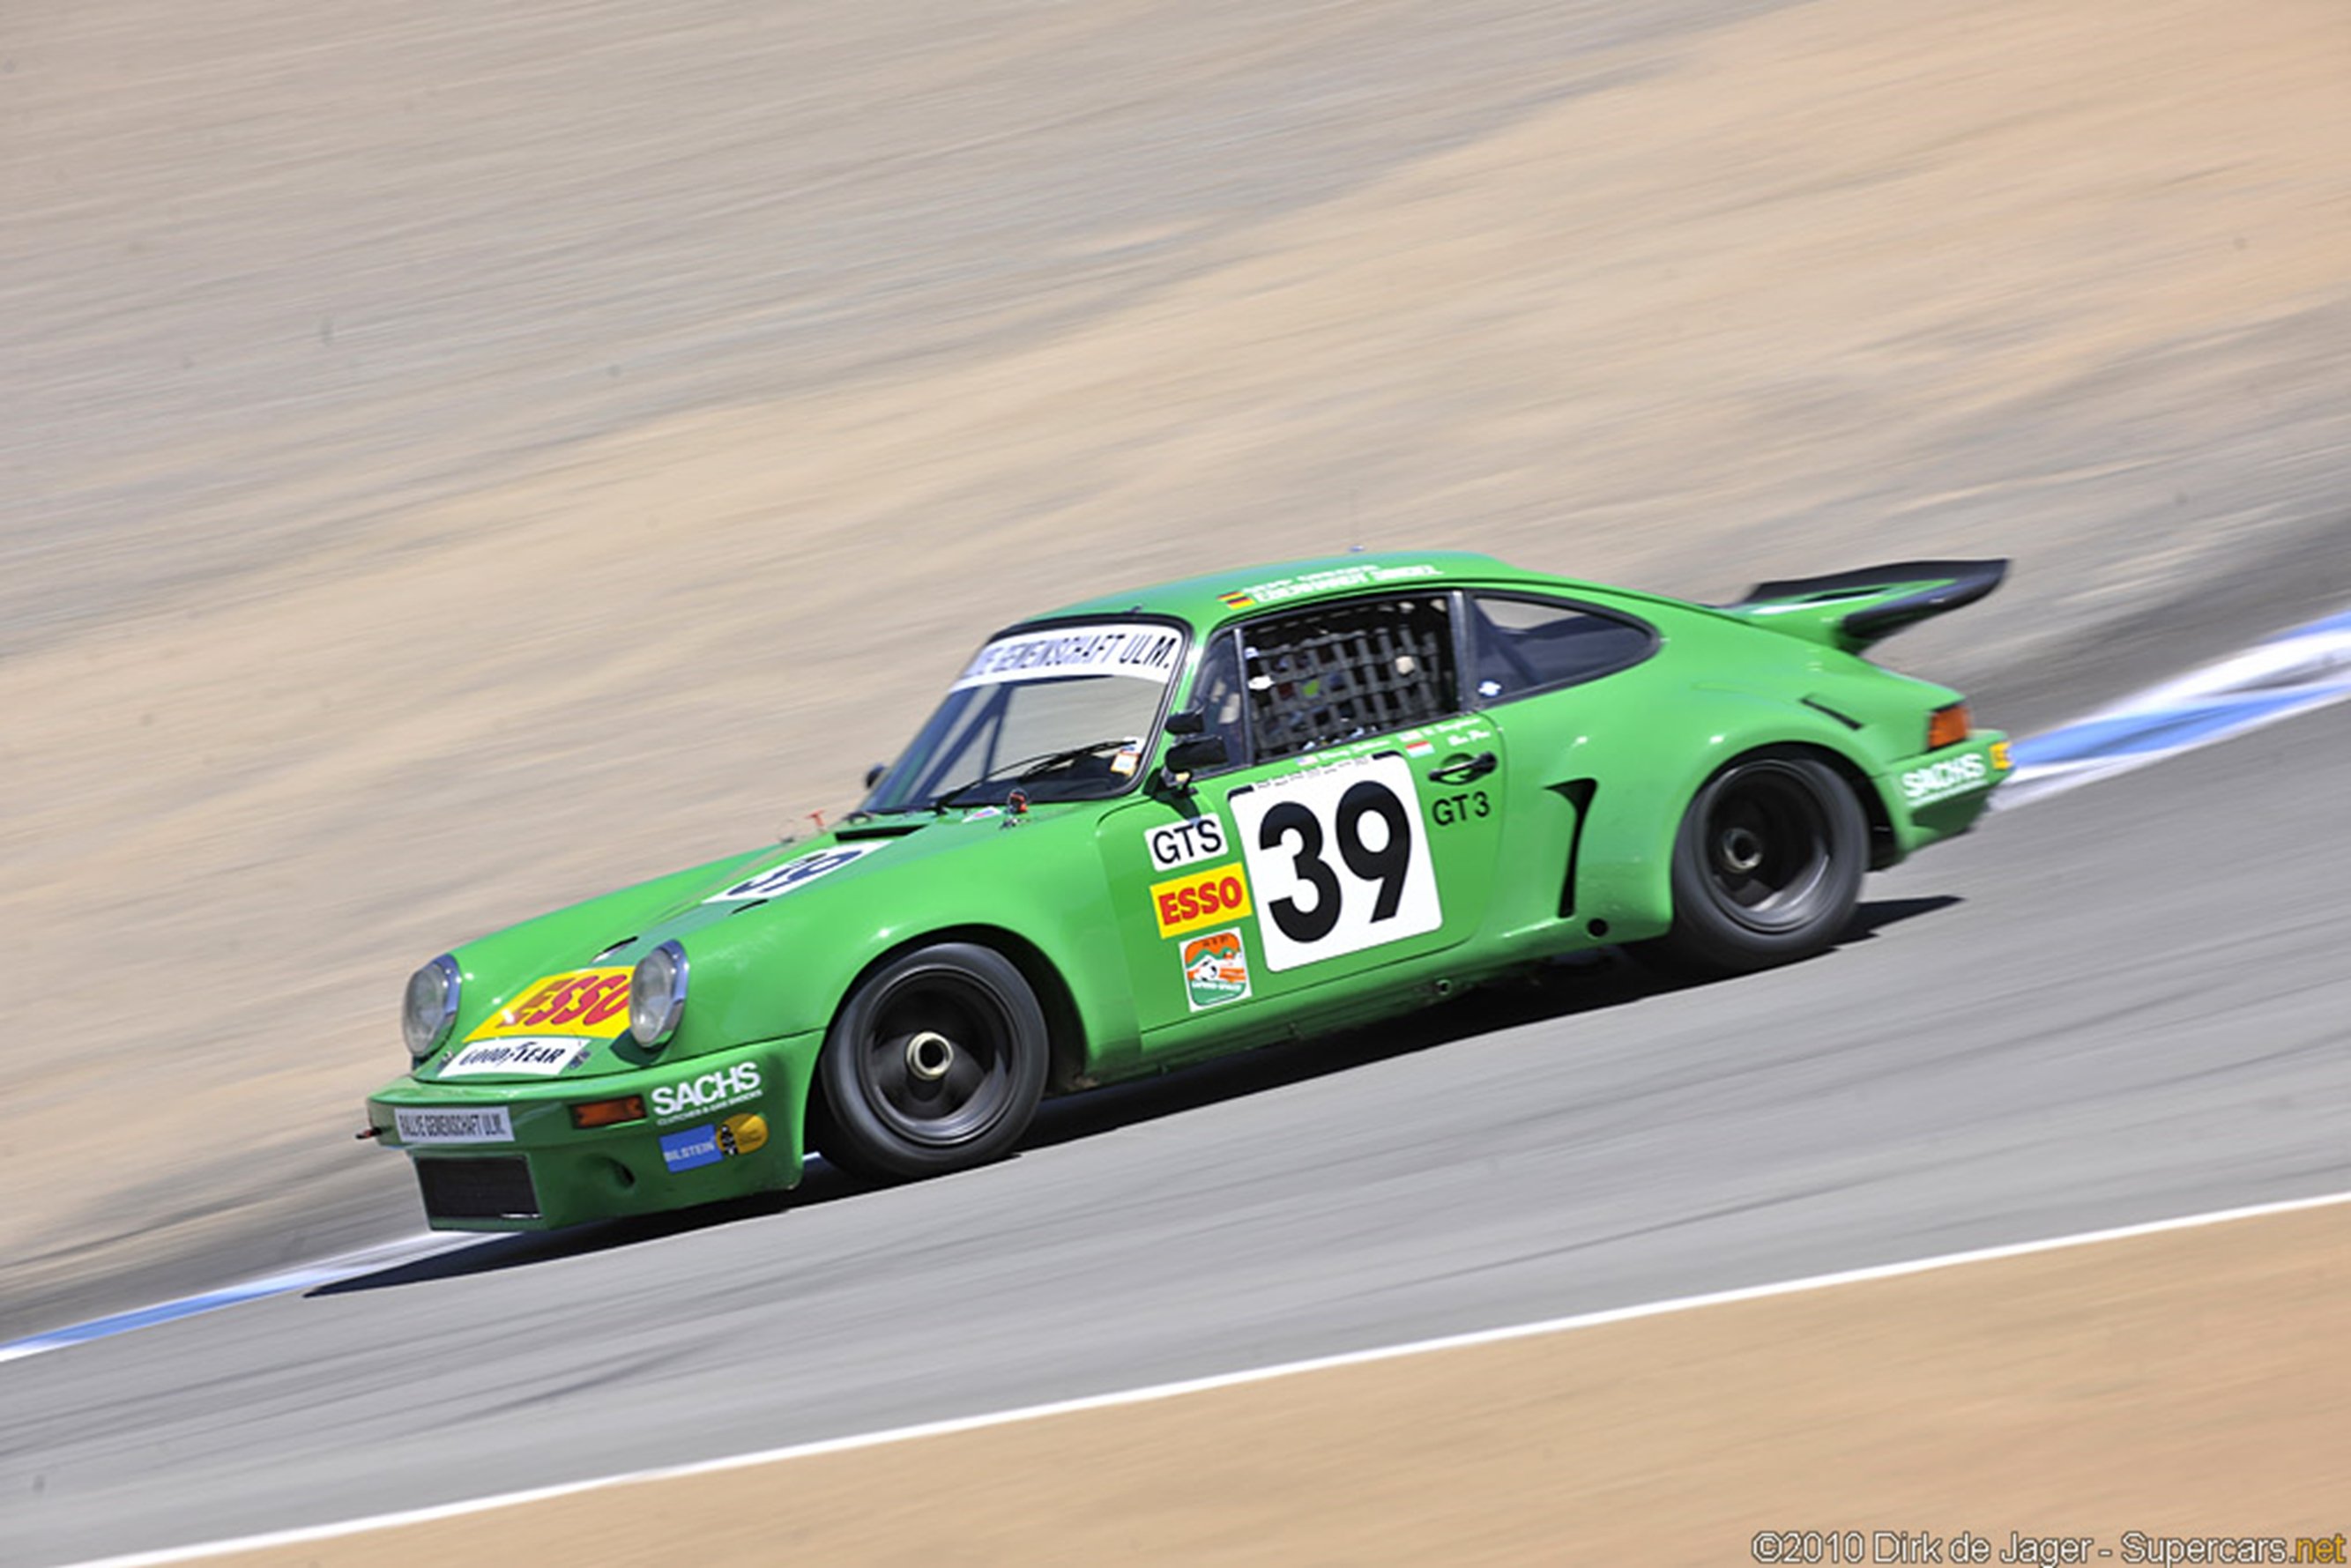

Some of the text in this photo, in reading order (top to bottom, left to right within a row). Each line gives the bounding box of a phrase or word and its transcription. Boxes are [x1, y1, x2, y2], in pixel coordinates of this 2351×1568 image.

[1901, 753, 1986, 797] SACHS
[1152, 819, 1222, 865] GTS
[1259, 780, 1412, 944] 39
[1157, 875, 1243, 926] ESSO
[651, 1062, 762, 1116] SACHS
[663, 1140, 715, 1163] BILSTEIN
